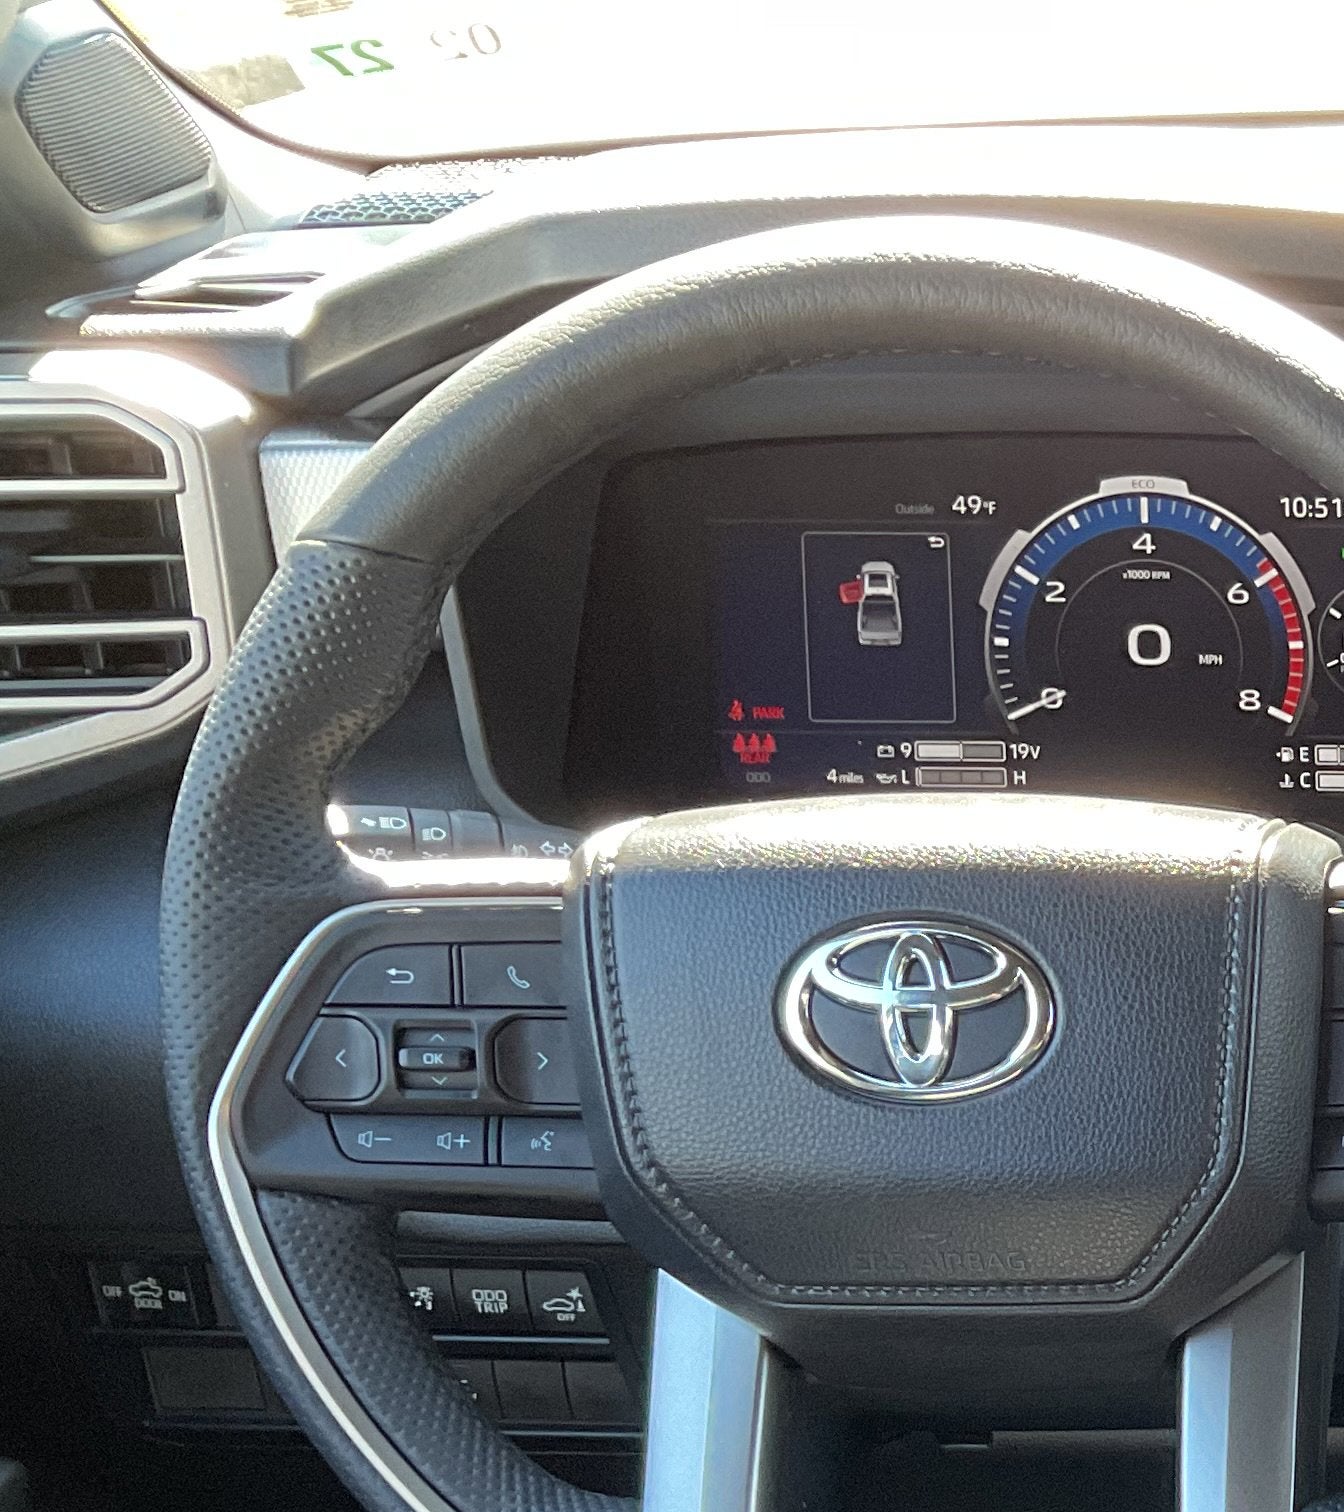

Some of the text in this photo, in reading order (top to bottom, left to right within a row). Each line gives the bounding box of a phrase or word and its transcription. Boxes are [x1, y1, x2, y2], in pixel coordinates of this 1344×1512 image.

[1131, 479, 1156, 490] ECO
[1280, 497, 1344, 519] 10:51
[1132, 533, 1156, 555] 4
[1045, 581, 1066, 603] 2
[1227, 582, 1251, 605] 6
[1128, 624, 1223, 666] 0 MPH
[1239, 690, 1262, 711] 8
[900, 743, 1041, 760] 9 19V
[1300, 748, 1309, 762] E
[902, 770, 910, 785] L
[1014, 771, 1027, 785] H
[1300, 773, 1311, 788] C
[423, 1052, 444, 1065] OK
[472, 1289, 507, 1302] ODO
[474, 1301, 508, 1313] TRIP
[557, 1313, 576, 1322] OFF
